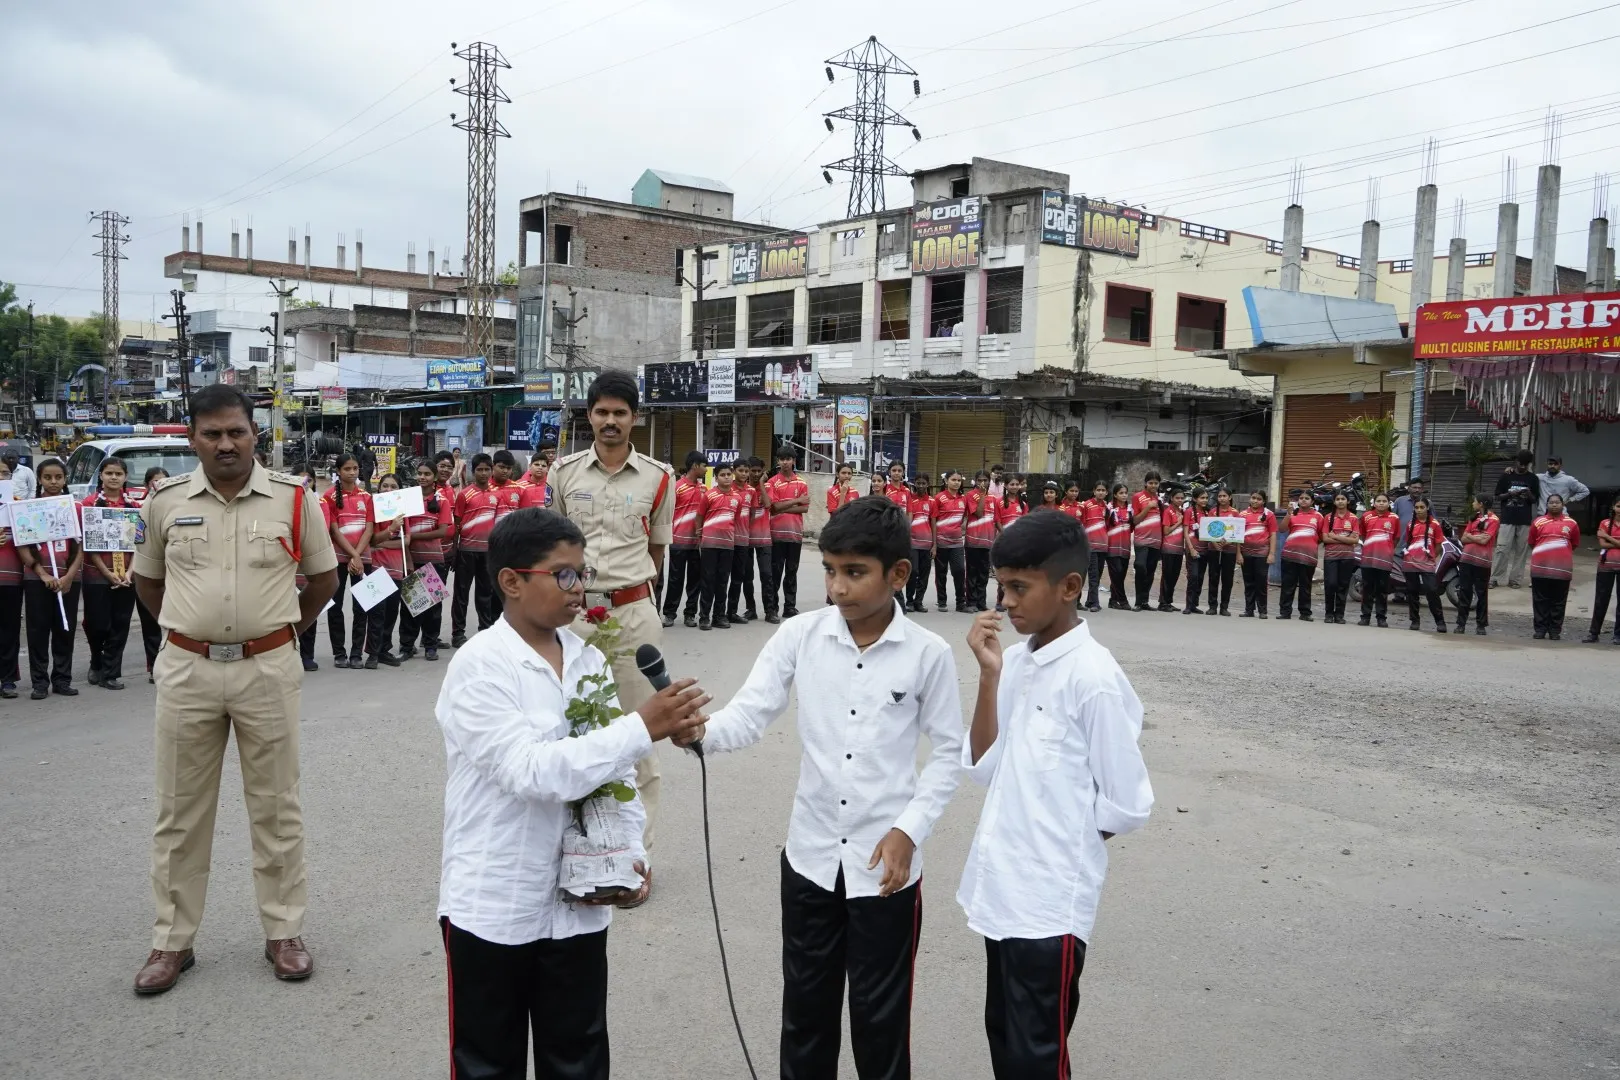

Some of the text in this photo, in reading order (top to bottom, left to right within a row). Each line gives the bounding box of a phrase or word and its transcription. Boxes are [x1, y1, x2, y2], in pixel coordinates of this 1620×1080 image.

[1083, 210, 1139, 254] LODGE
[912, 231, 979, 273] LODGE
[761, 245, 807, 280] LODGE
[1423, 311, 1462, 320] The New
[1420, 342, 1449, 355] MULTI
[1451, 340, 1490, 353] CUISINE
[1492, 339, 1528, 352] FAMILY
[1530, 336, 1600, 350] RESTAURANT
[1602, 336, 1610, 348] &
[448, 361, 482, 373] AUTOMOBILE
[368, 436, 395, 444] SV BAR
[708, 452, 720, 463] SV
